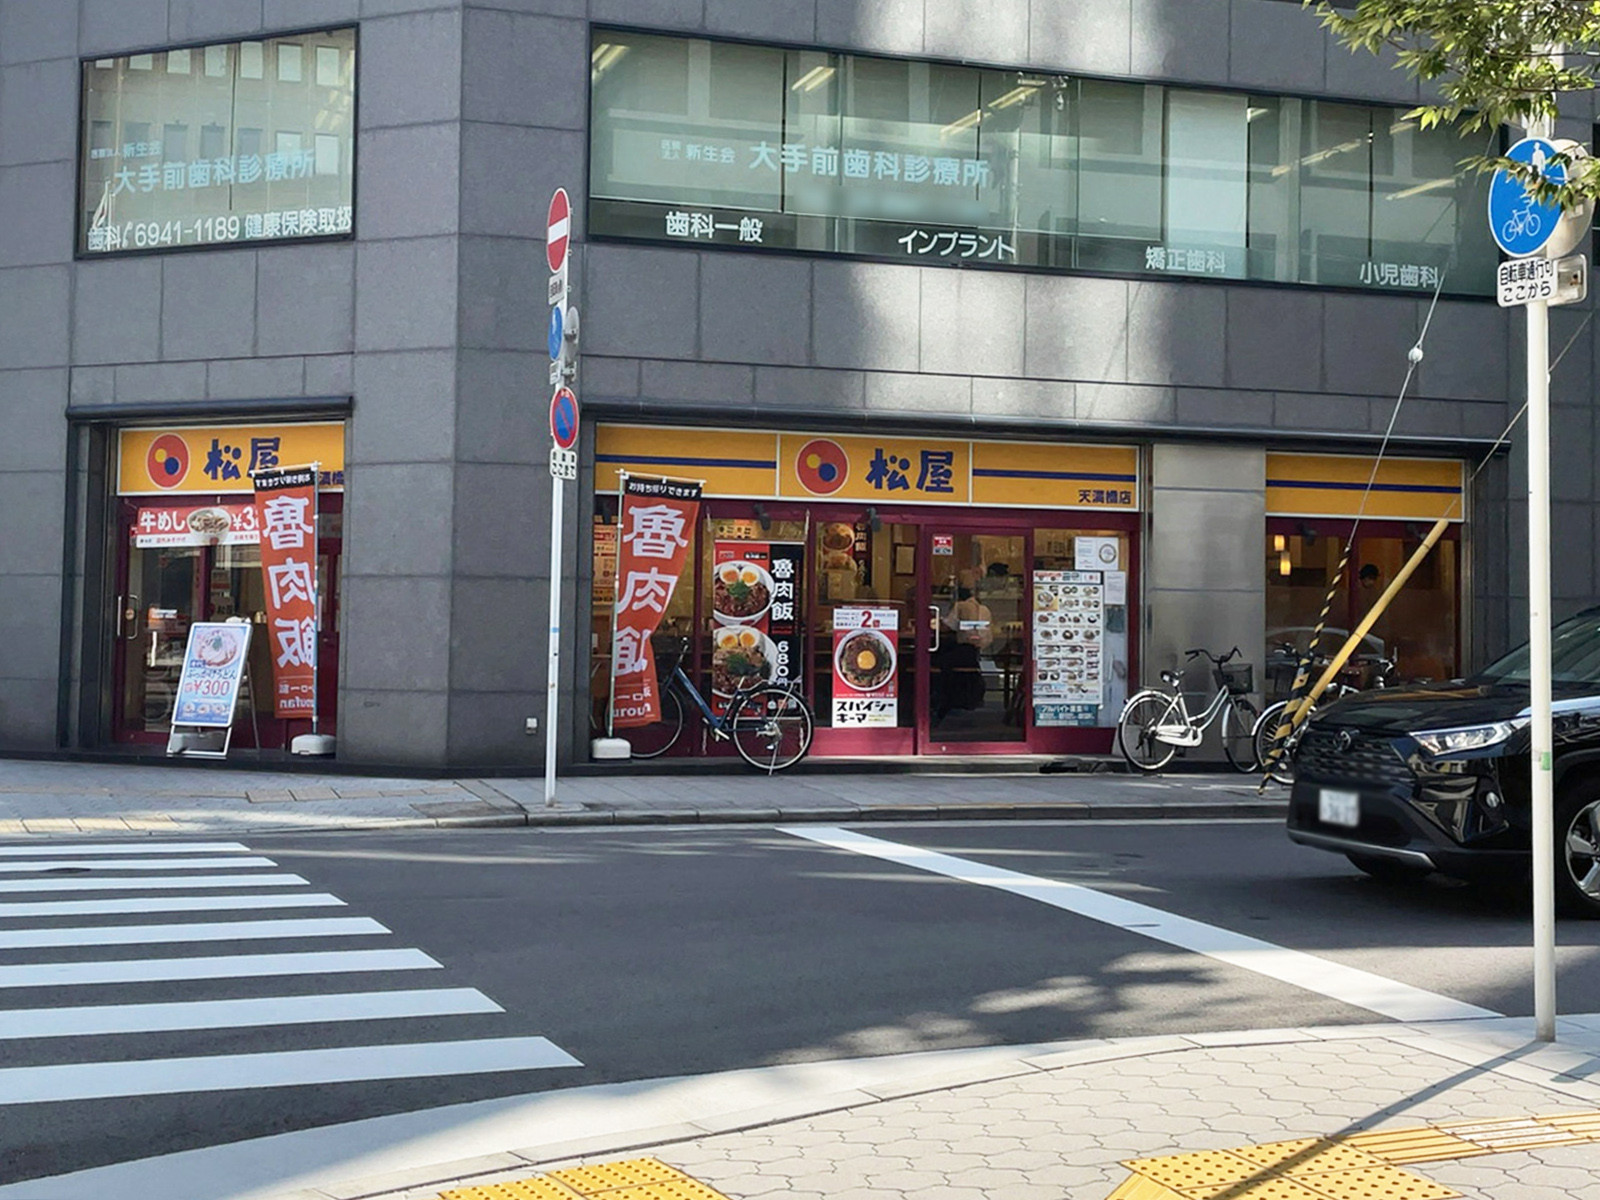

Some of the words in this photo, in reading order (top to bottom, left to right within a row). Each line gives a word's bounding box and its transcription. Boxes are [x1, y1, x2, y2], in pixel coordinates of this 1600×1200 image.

[112, 149, 316, 195] 大手前歯科診療所
[686, 144, 735, 163] 新生会
[749, 140, 989, 188] 大手前歯科診療所
[135, 216, 239, 247] 6941-1189
[244, 206, 352, 238] 健康保険取扱
[666, 211, 763, 243] 歯科一般
[898, 229, 1016, 259] インプラント
[1145, 245, 1226, 273] 矯正歯科
[1359, 261, 1439, 288] 小児歯科
[1500, 260, 1554, 286] 自転車通行可
[1503, 281, 1551, 302] ここから
[203, 437, 280, 481] 松屋
[866, 448, 954, 493] 松屋
[628, 481, 697, 498] お持ち帰りできます
[1078, 489, 1131, 505] 天満橋店
[140, 510, 186, 533] 牛めし
[232, 506, 260, 531] ¥3
[771, 558, 795, 621] 魯肉飯
[194, 679, 231, 696] ¥300
[836, 700, 895, 712] スパイシー
[836, 713, 868, 724] キーマ
